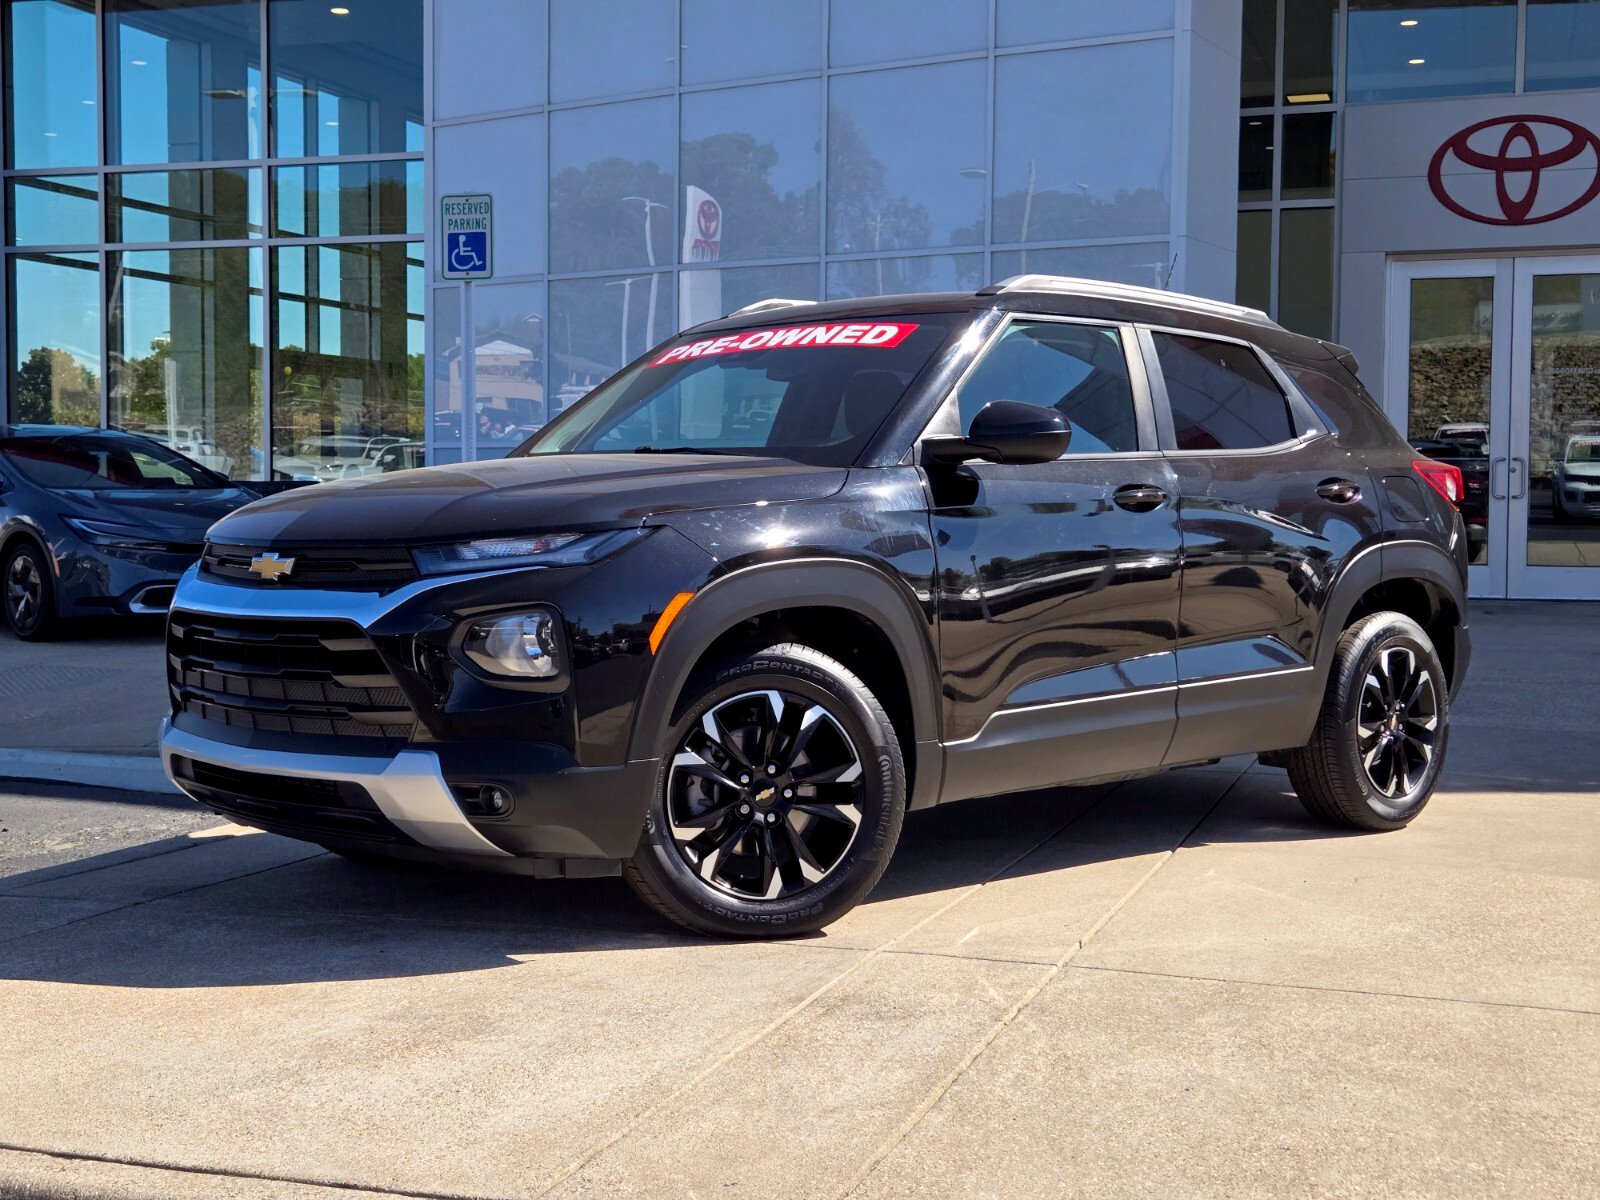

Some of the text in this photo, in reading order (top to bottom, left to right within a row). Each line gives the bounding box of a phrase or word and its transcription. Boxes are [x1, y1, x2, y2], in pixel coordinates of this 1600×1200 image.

[445, 202, 489, 215] RESERVED
[448, 218, 487, 230] PARKING
[656, 325, 899, 365] PRE-OWNED
